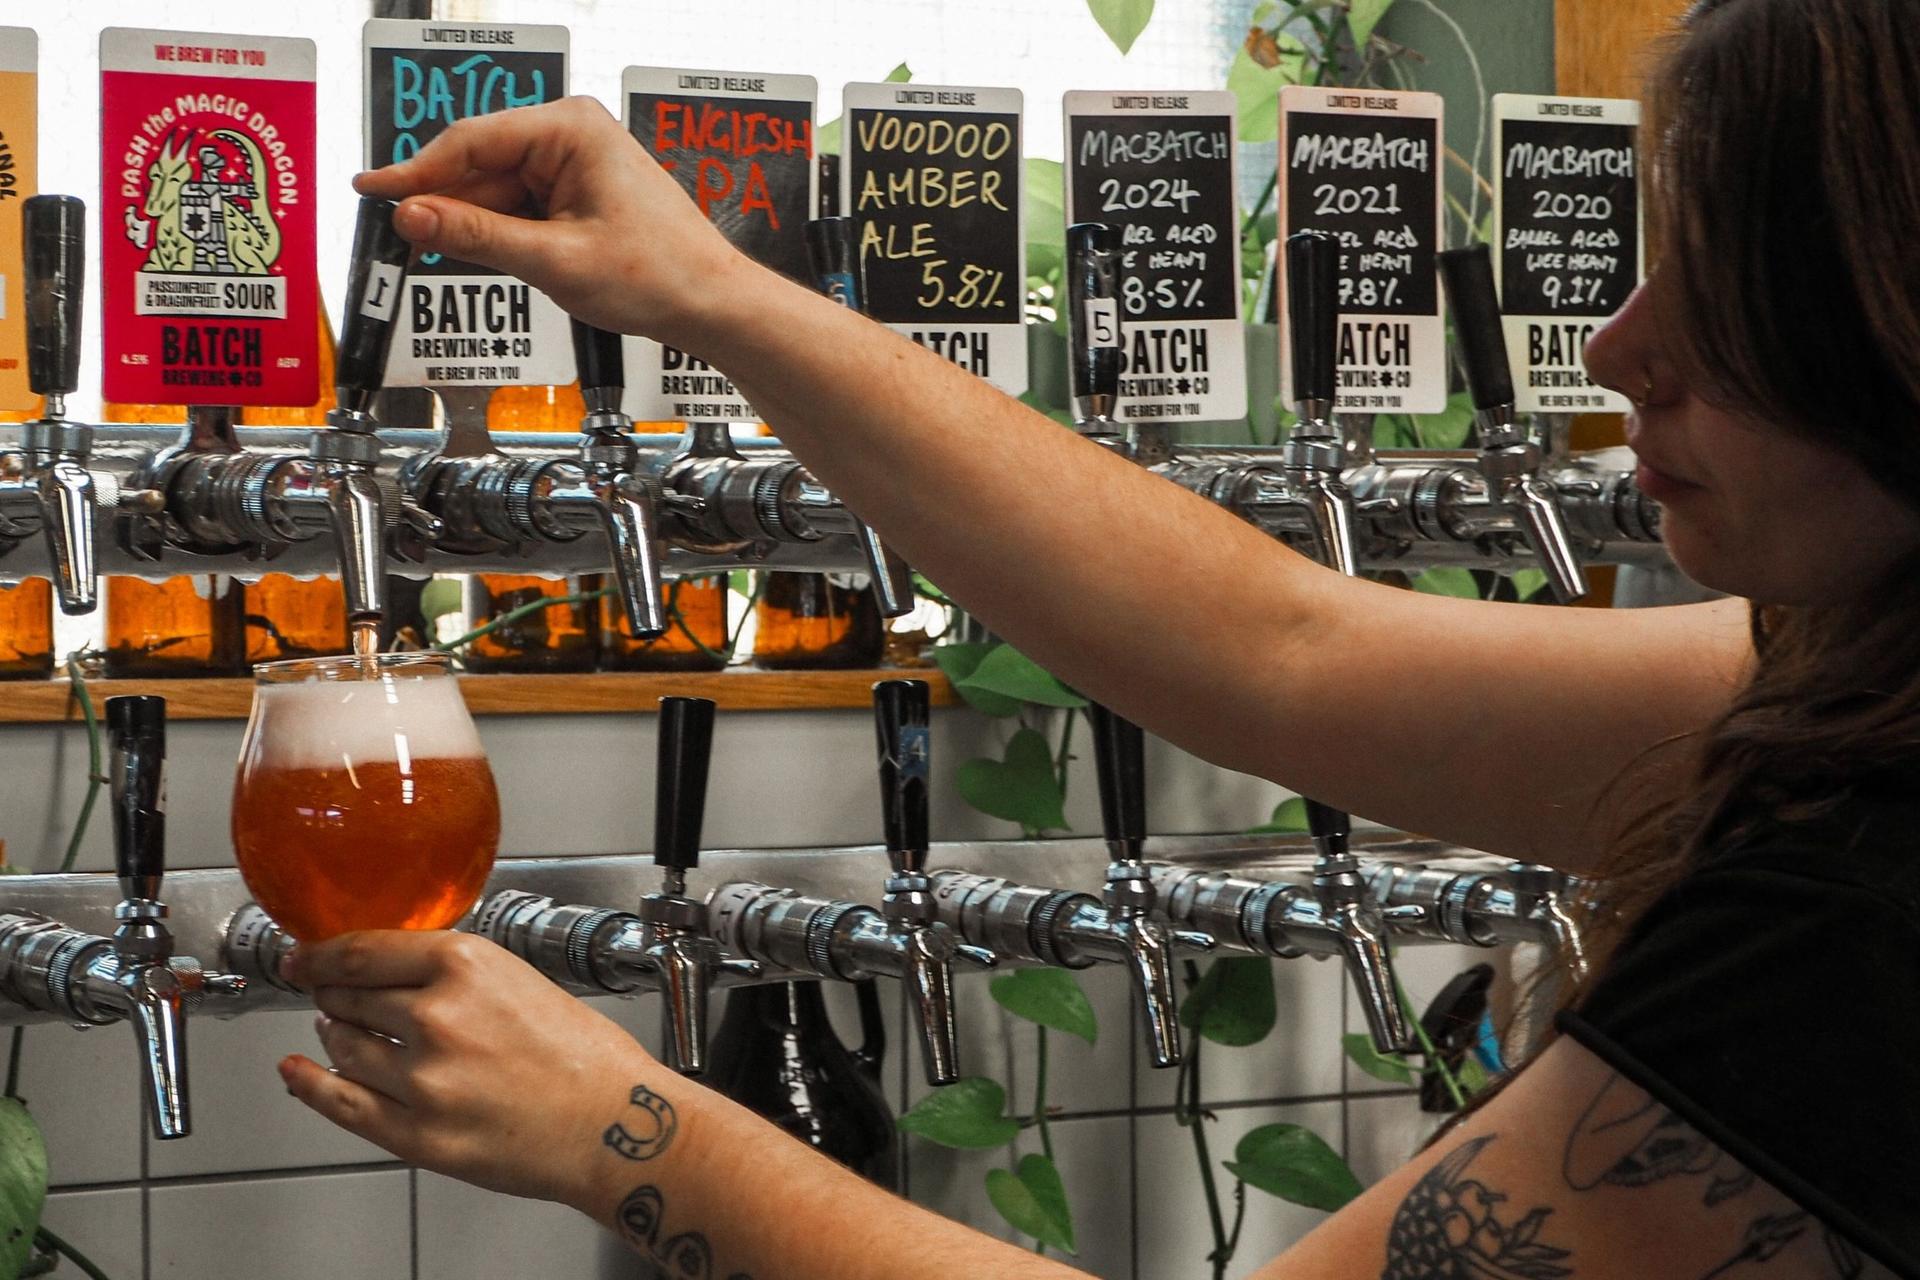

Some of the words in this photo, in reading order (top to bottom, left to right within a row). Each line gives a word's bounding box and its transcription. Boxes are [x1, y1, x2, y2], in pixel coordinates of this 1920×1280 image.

[423, 28, 466, 42] LIMITED
[470, 30, 514, 44] RELEASE
[155, 45, 174, 61] WE
[178, 47, 212, 63] BREW
[216, 49, 238, 65] FOR
[242, 50, 266, 67] YOU
[393, 54, 545, 128] BATCH
[678, 75, 719, 90] LIMITED
[724, 78, 765, 92] RELEASE
[895, 91, 934, 104] LIMITED
[938, 92, 976, 105] RELEASE
[1113, 96, 1148, 109] LIMITED
[1152, 96, 1189, 109] RELEASE
[655, 101, 813, 160] ENGLISH
[858, 112, 1011, 160] VOODOO
[121, 135, 151, 198] PASH
[175, 93, 249, 121] MAGIC
[247, 112, 298, 204] DRAGON
[1080, 130, 1228, 167] MACBATCH
[1291, 132, 1428, 174] MACBATCH
[1505, 142, 1633, 179] MACBATCH
[858, 167, 1009, 211] AMBER
[1099, 179, 1201, 214] 2024
[1313, 183, 1402, 215] 2021
[1532, 191, 1612, 220] 2020
[860, 220, 937, 259] ALE
[1166, 224, 1217, 245] AGED
[149, 281, 217, 294] PASSIONFRUIT
[224, 283, 277, 310] SOUR
[368, 276, 389, 308] 1
[917, 259, 1006, 308] 5.8%
[1122, 276, 1205, 315] 8.5%
[1338, 278, 1403, 306] 7.8%
[1542, 276, 1607, 308] 9.1%
[411, 284, 531, 334] BATCH
[1094, 311, 1111, 342] 5
[162, 326, 262, 367] BATCH
[413, 338, 488, 358] BREWING
[513, 338, 531, 357] CO
[912, 332, 988, 377] TCH
[1336, 322, 1410, 366] ATCH
[163, 369, 225, 386] BREWING
[246, 371, 263, 386] CO
[426, 366, 443, 380] WE
[446, 366, 475, 380] BREW
[479, 366, 497, 380] FOR
[500, 366, 520, 380] YOU
[662, 376, 734, 395] BREWING
[1118, 378, 1174, 397] REWING
[1193, 377, 1209, 395] CO
[1336, 371, 1377, 388] EWING
[1395, 371, 1411, 388] CO
[674, 403, 690, 417] WE
[693, 403, 720, 417] BREW
[724, 404, 741, 417] FOR
[1124, 405, 1137, 417] WE
[1140, 405, 1163, 417] BREW
[1166, 404, 1181, 416] FOR
[1184, 403, 1200, 415] YOU
[910, 735, 927, 762] 4
